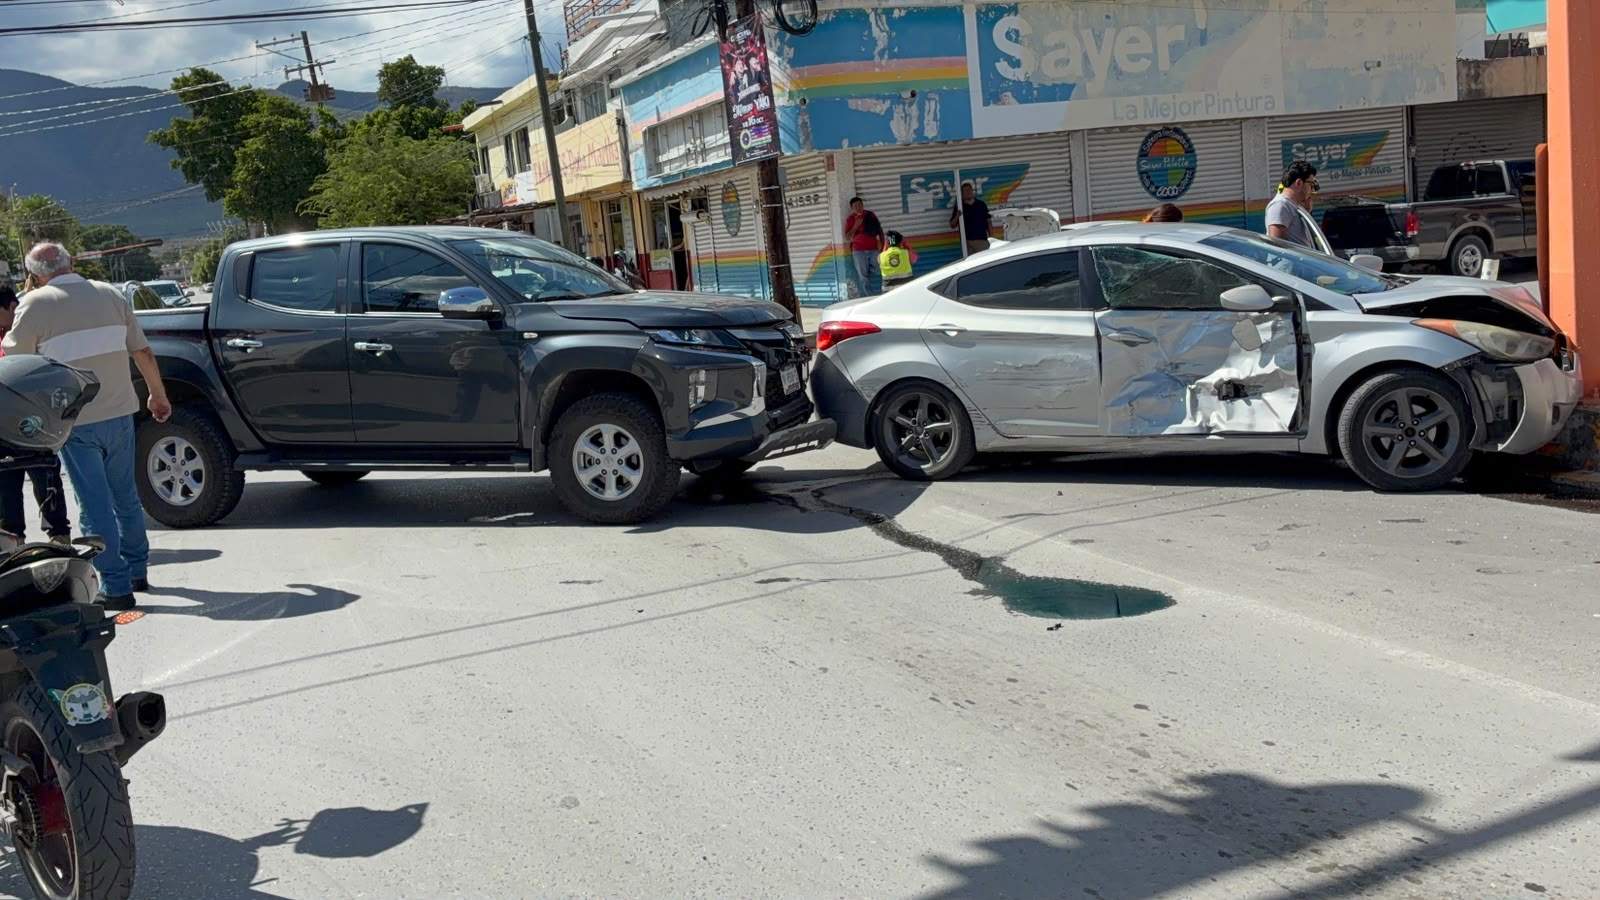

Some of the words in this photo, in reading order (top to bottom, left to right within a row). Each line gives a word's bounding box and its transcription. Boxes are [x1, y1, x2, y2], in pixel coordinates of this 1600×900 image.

[992, 15, 1185, 99] Sayer
[1112, 99, 1138, 121] La
[1143, 95, 1201, 122] Mejor
[1204, 91, 1276, 115] Pintura
[1291, 142, 1352, 170] Sayer
